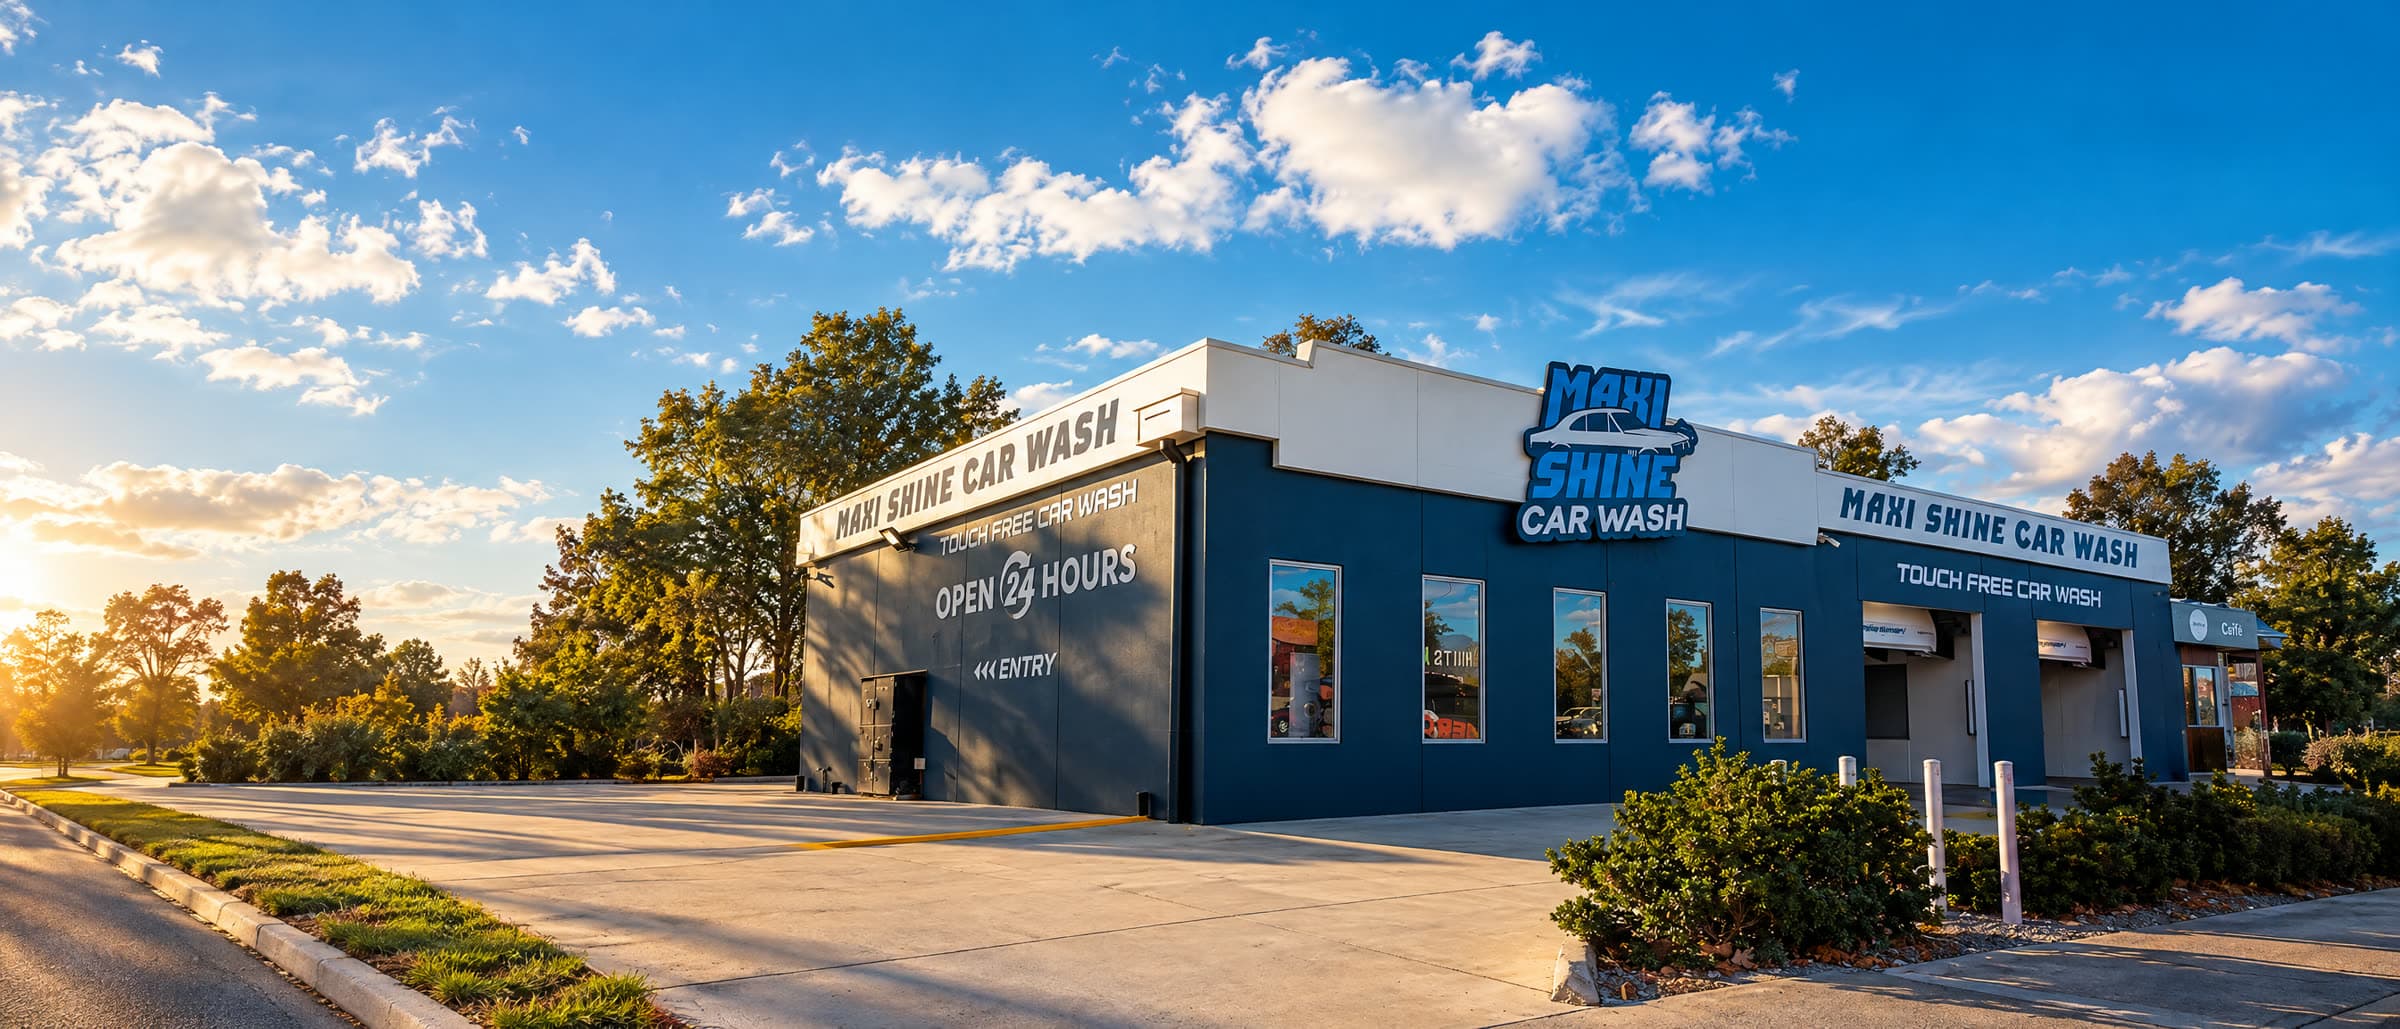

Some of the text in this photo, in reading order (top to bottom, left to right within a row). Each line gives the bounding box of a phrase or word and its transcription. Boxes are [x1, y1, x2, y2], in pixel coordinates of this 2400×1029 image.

[1545, 367, 1667, 428] MAXI
[836, 398, 1119, 540] MAXI SHINE CAR WASH
[1531, 451, 1677, 499] SHINE
[940, 478, 1138, 556] TOUCH FREE CAR WASH
[1521, 503, 1684, 536] CAR WASH
[1840, 487, 2138, 569] MAXI SHINE CAR WASH
[935, 543, 1137, 620] OPEN 24 HOURS
[1897, 563, 2102, 608] TOUCH FREE CAR WASH
[998, 652, 1058, 680] ENTRY
